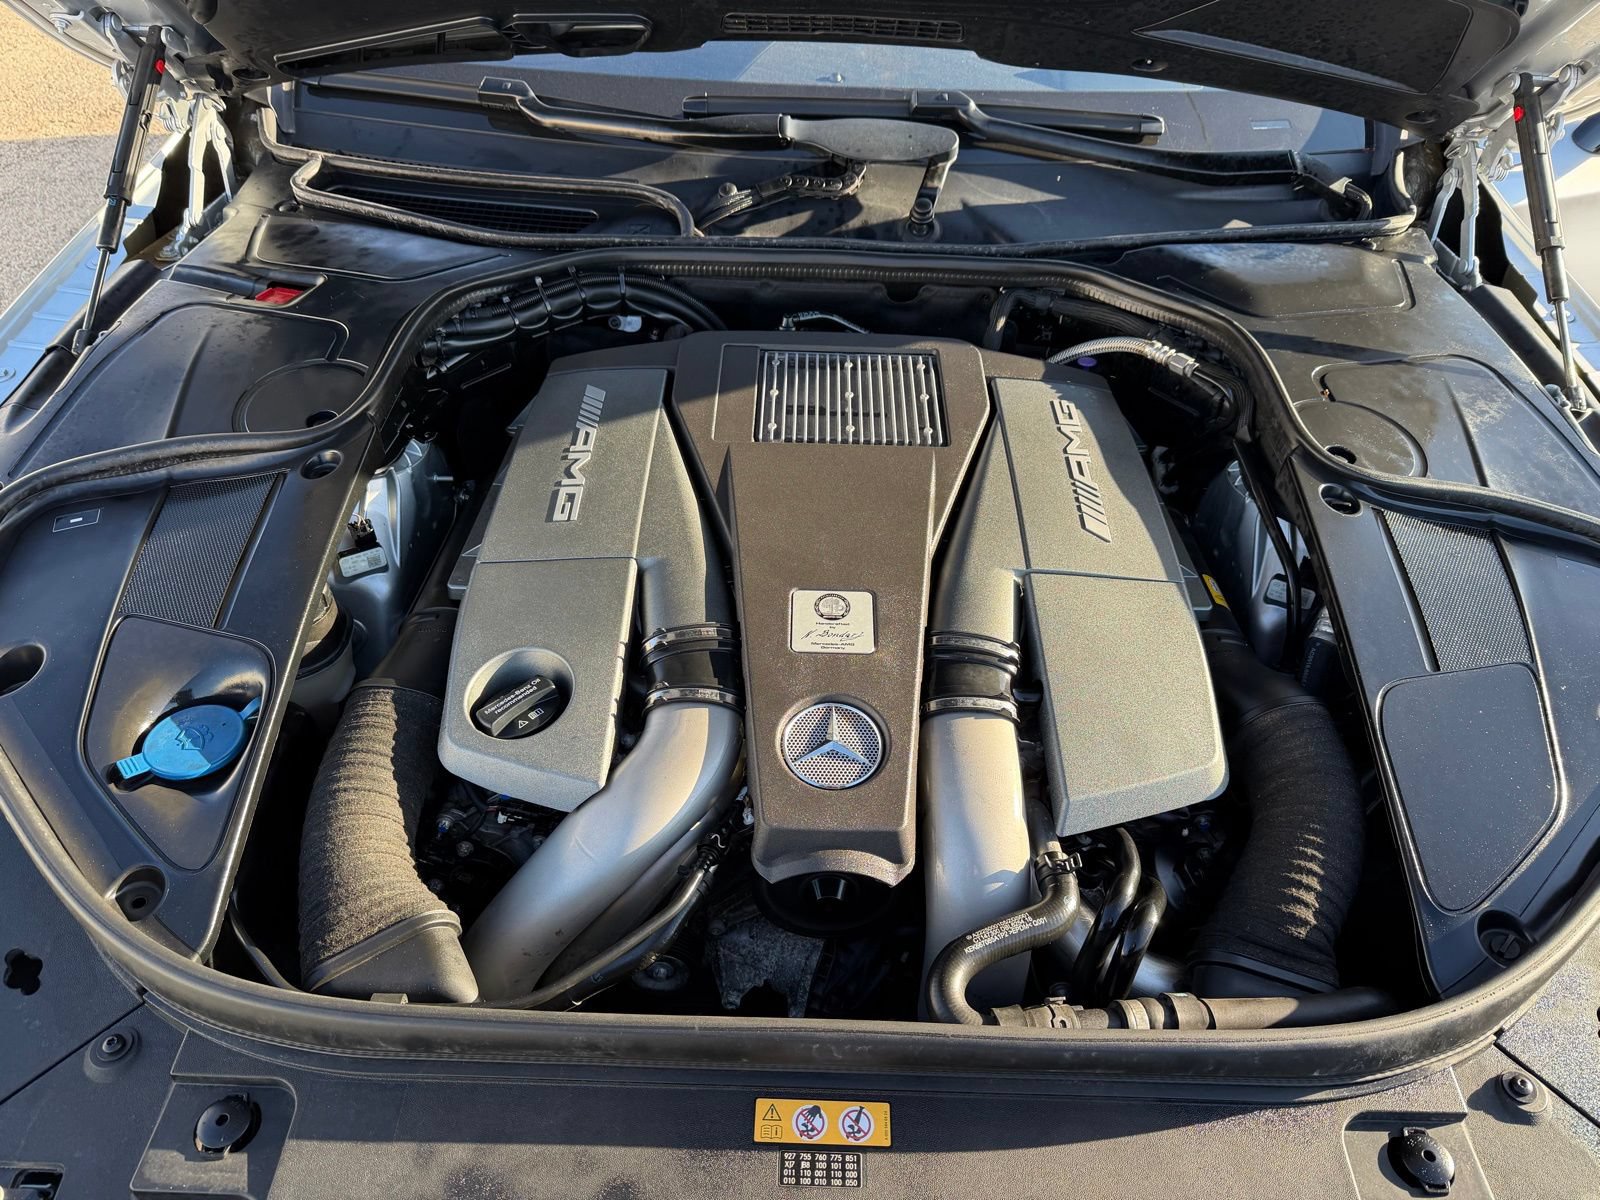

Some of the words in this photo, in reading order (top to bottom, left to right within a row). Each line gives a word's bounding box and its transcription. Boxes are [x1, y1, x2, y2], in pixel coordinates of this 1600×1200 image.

[552, 418, 600, 522] AMG
[1051, 399, 1098, 492] AMG
[484, 684, 531, 715] Mercedes-Benz
[530, 678, 542, 686] Oil
[494, 686, 538, 715] recommended
